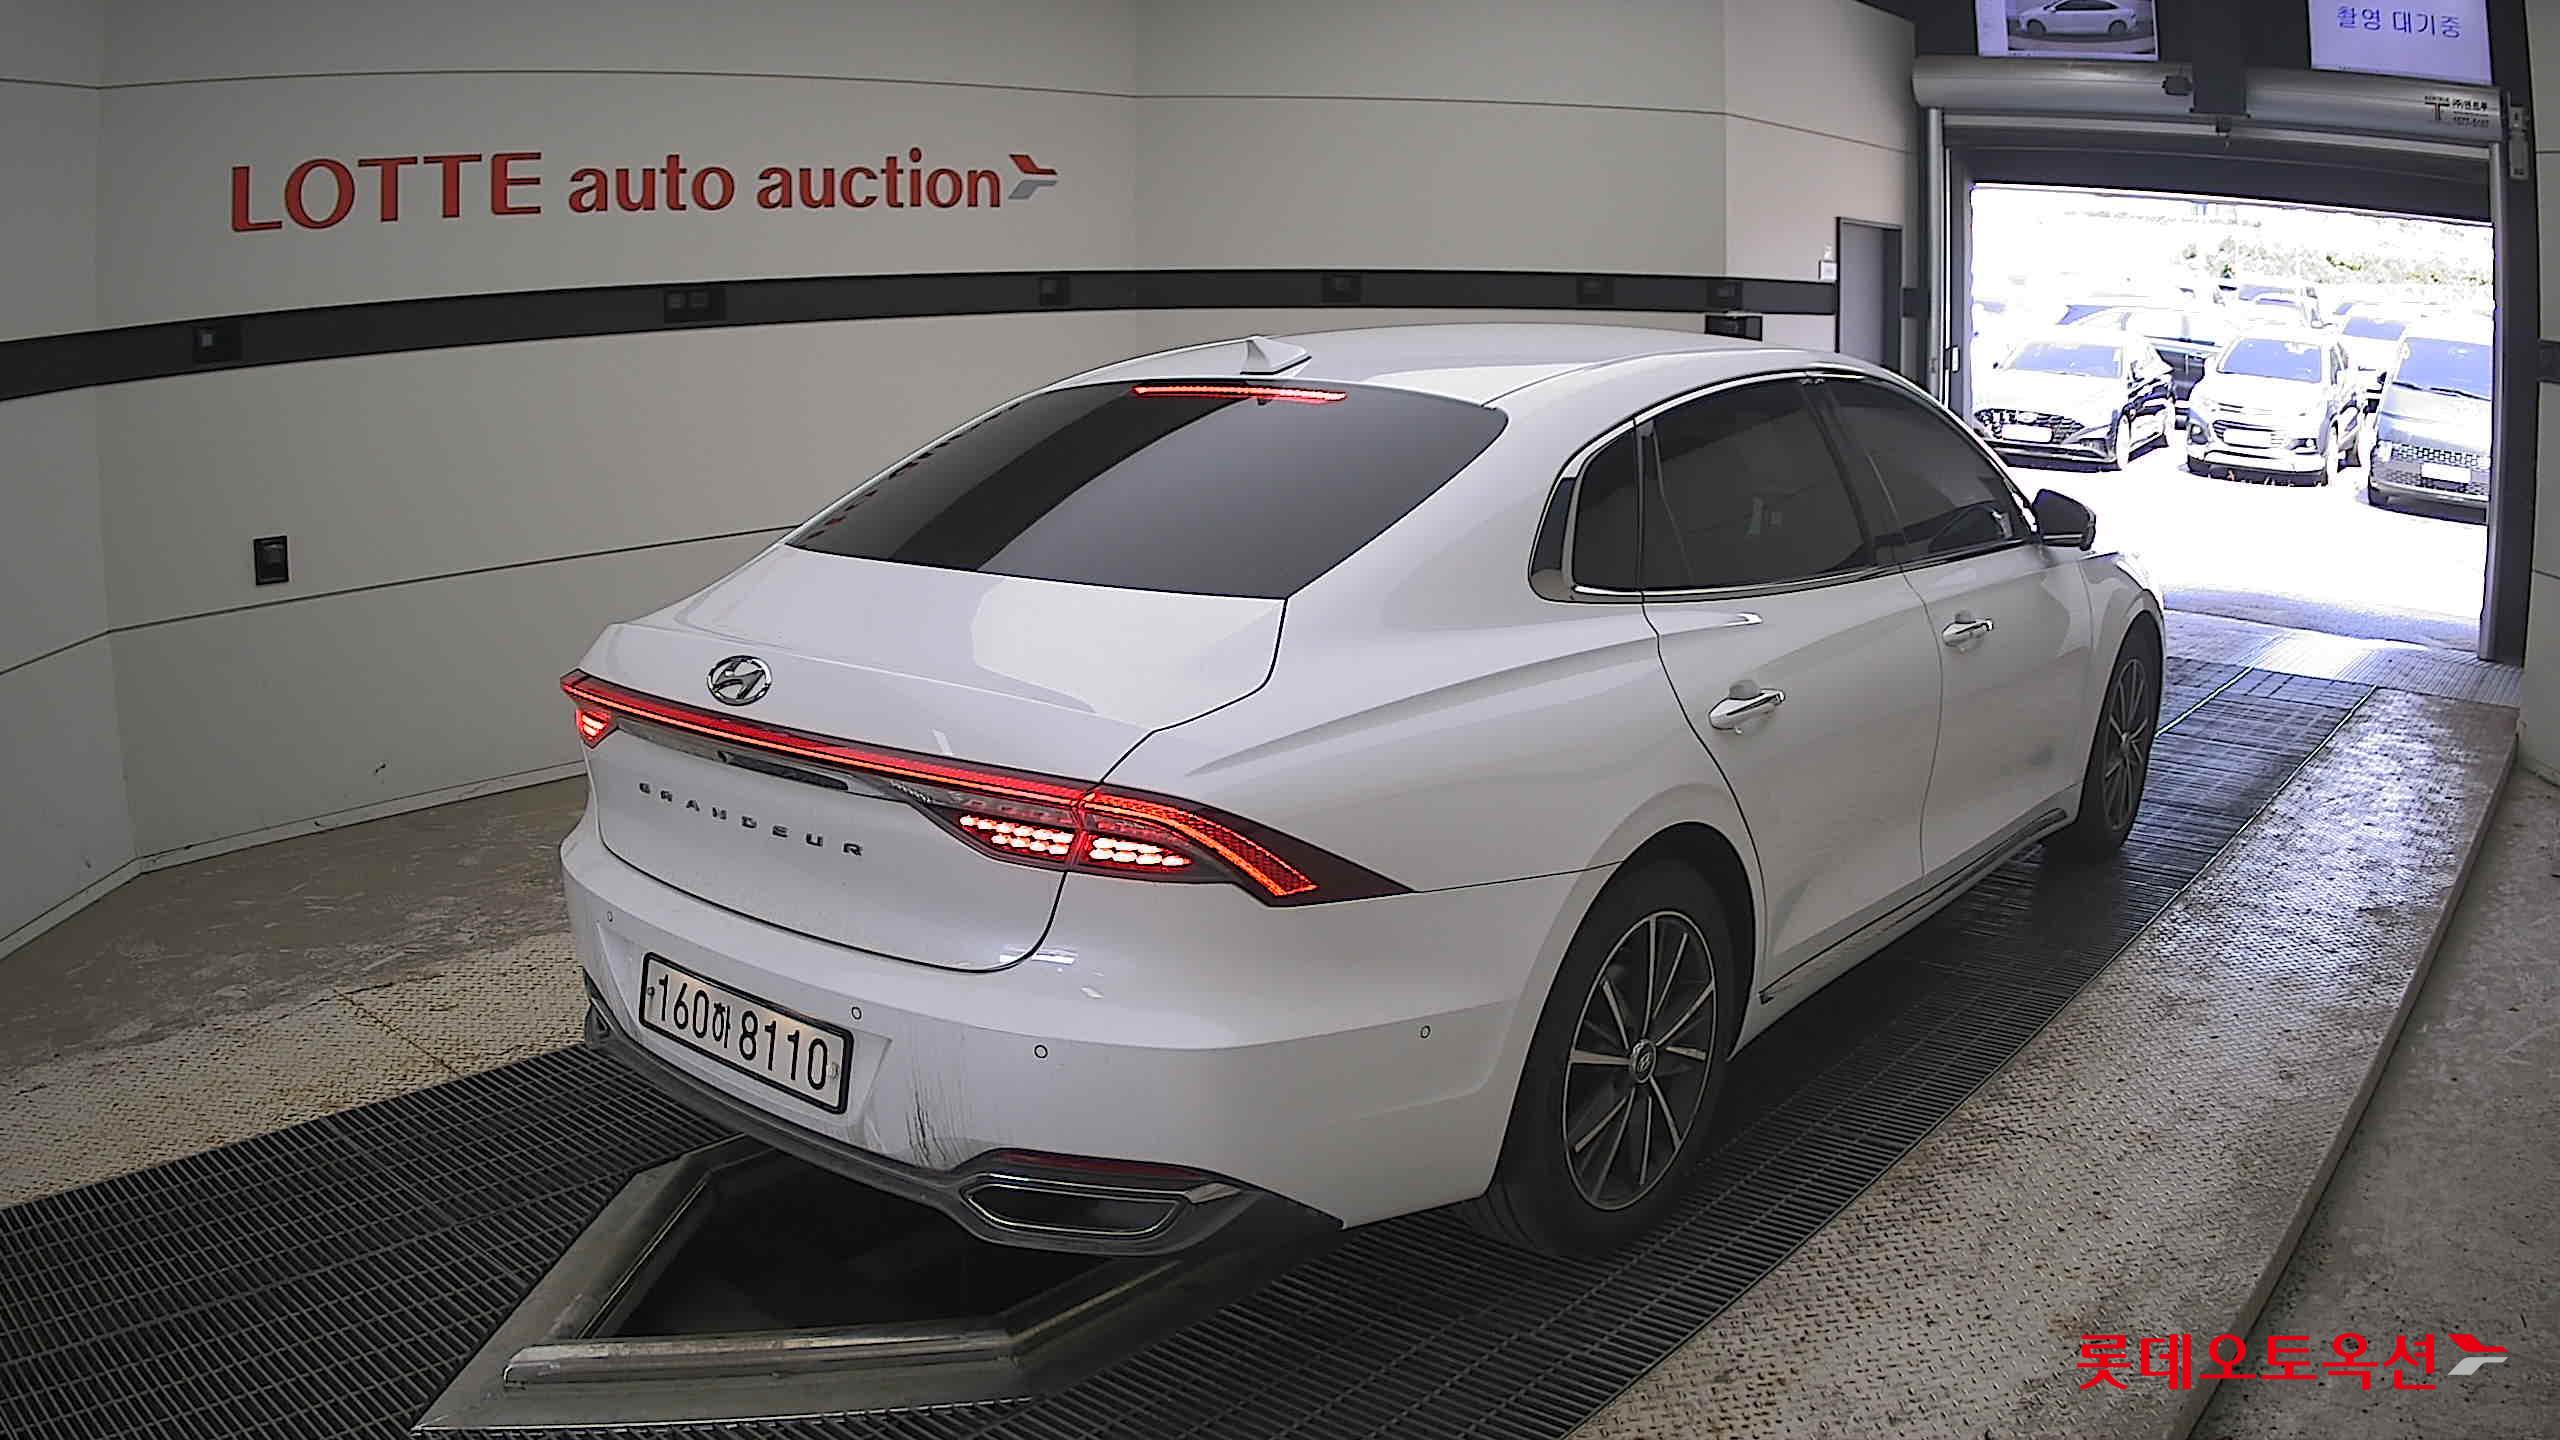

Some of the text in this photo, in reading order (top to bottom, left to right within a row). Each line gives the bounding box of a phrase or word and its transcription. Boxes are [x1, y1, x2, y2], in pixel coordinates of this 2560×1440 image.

[2337, 5, 2461, 39] 촬영 대기중
[231, 147, 1002, 231] LOTTE auto auction
[639, 782, 864, 857] GRANDEUR
[658, 974, 829, 1091] 160하 8110
